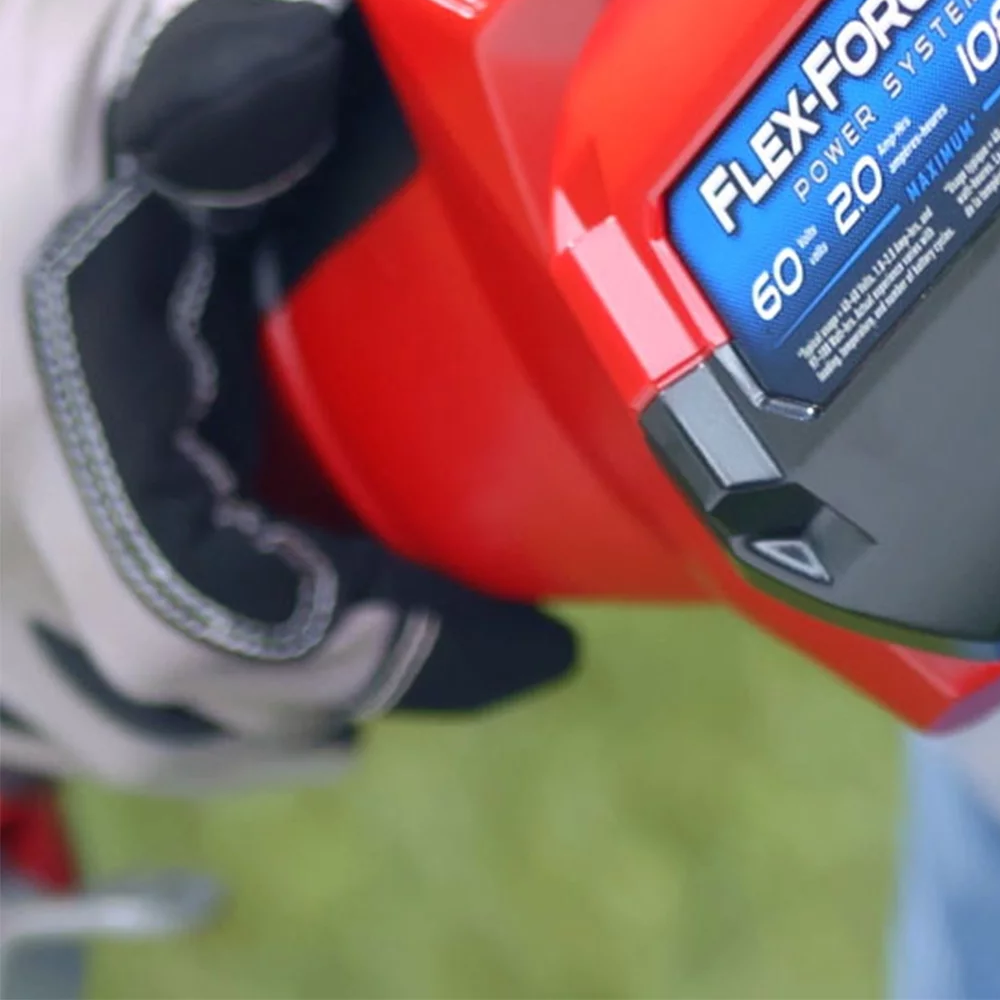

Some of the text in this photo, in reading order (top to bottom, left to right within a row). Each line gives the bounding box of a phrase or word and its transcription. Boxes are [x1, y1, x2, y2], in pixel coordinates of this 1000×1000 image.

[794, 106, 875, 201] POWER
[752, 248, 803, 320] 60
[827, 155, 882, 234] 2.0
